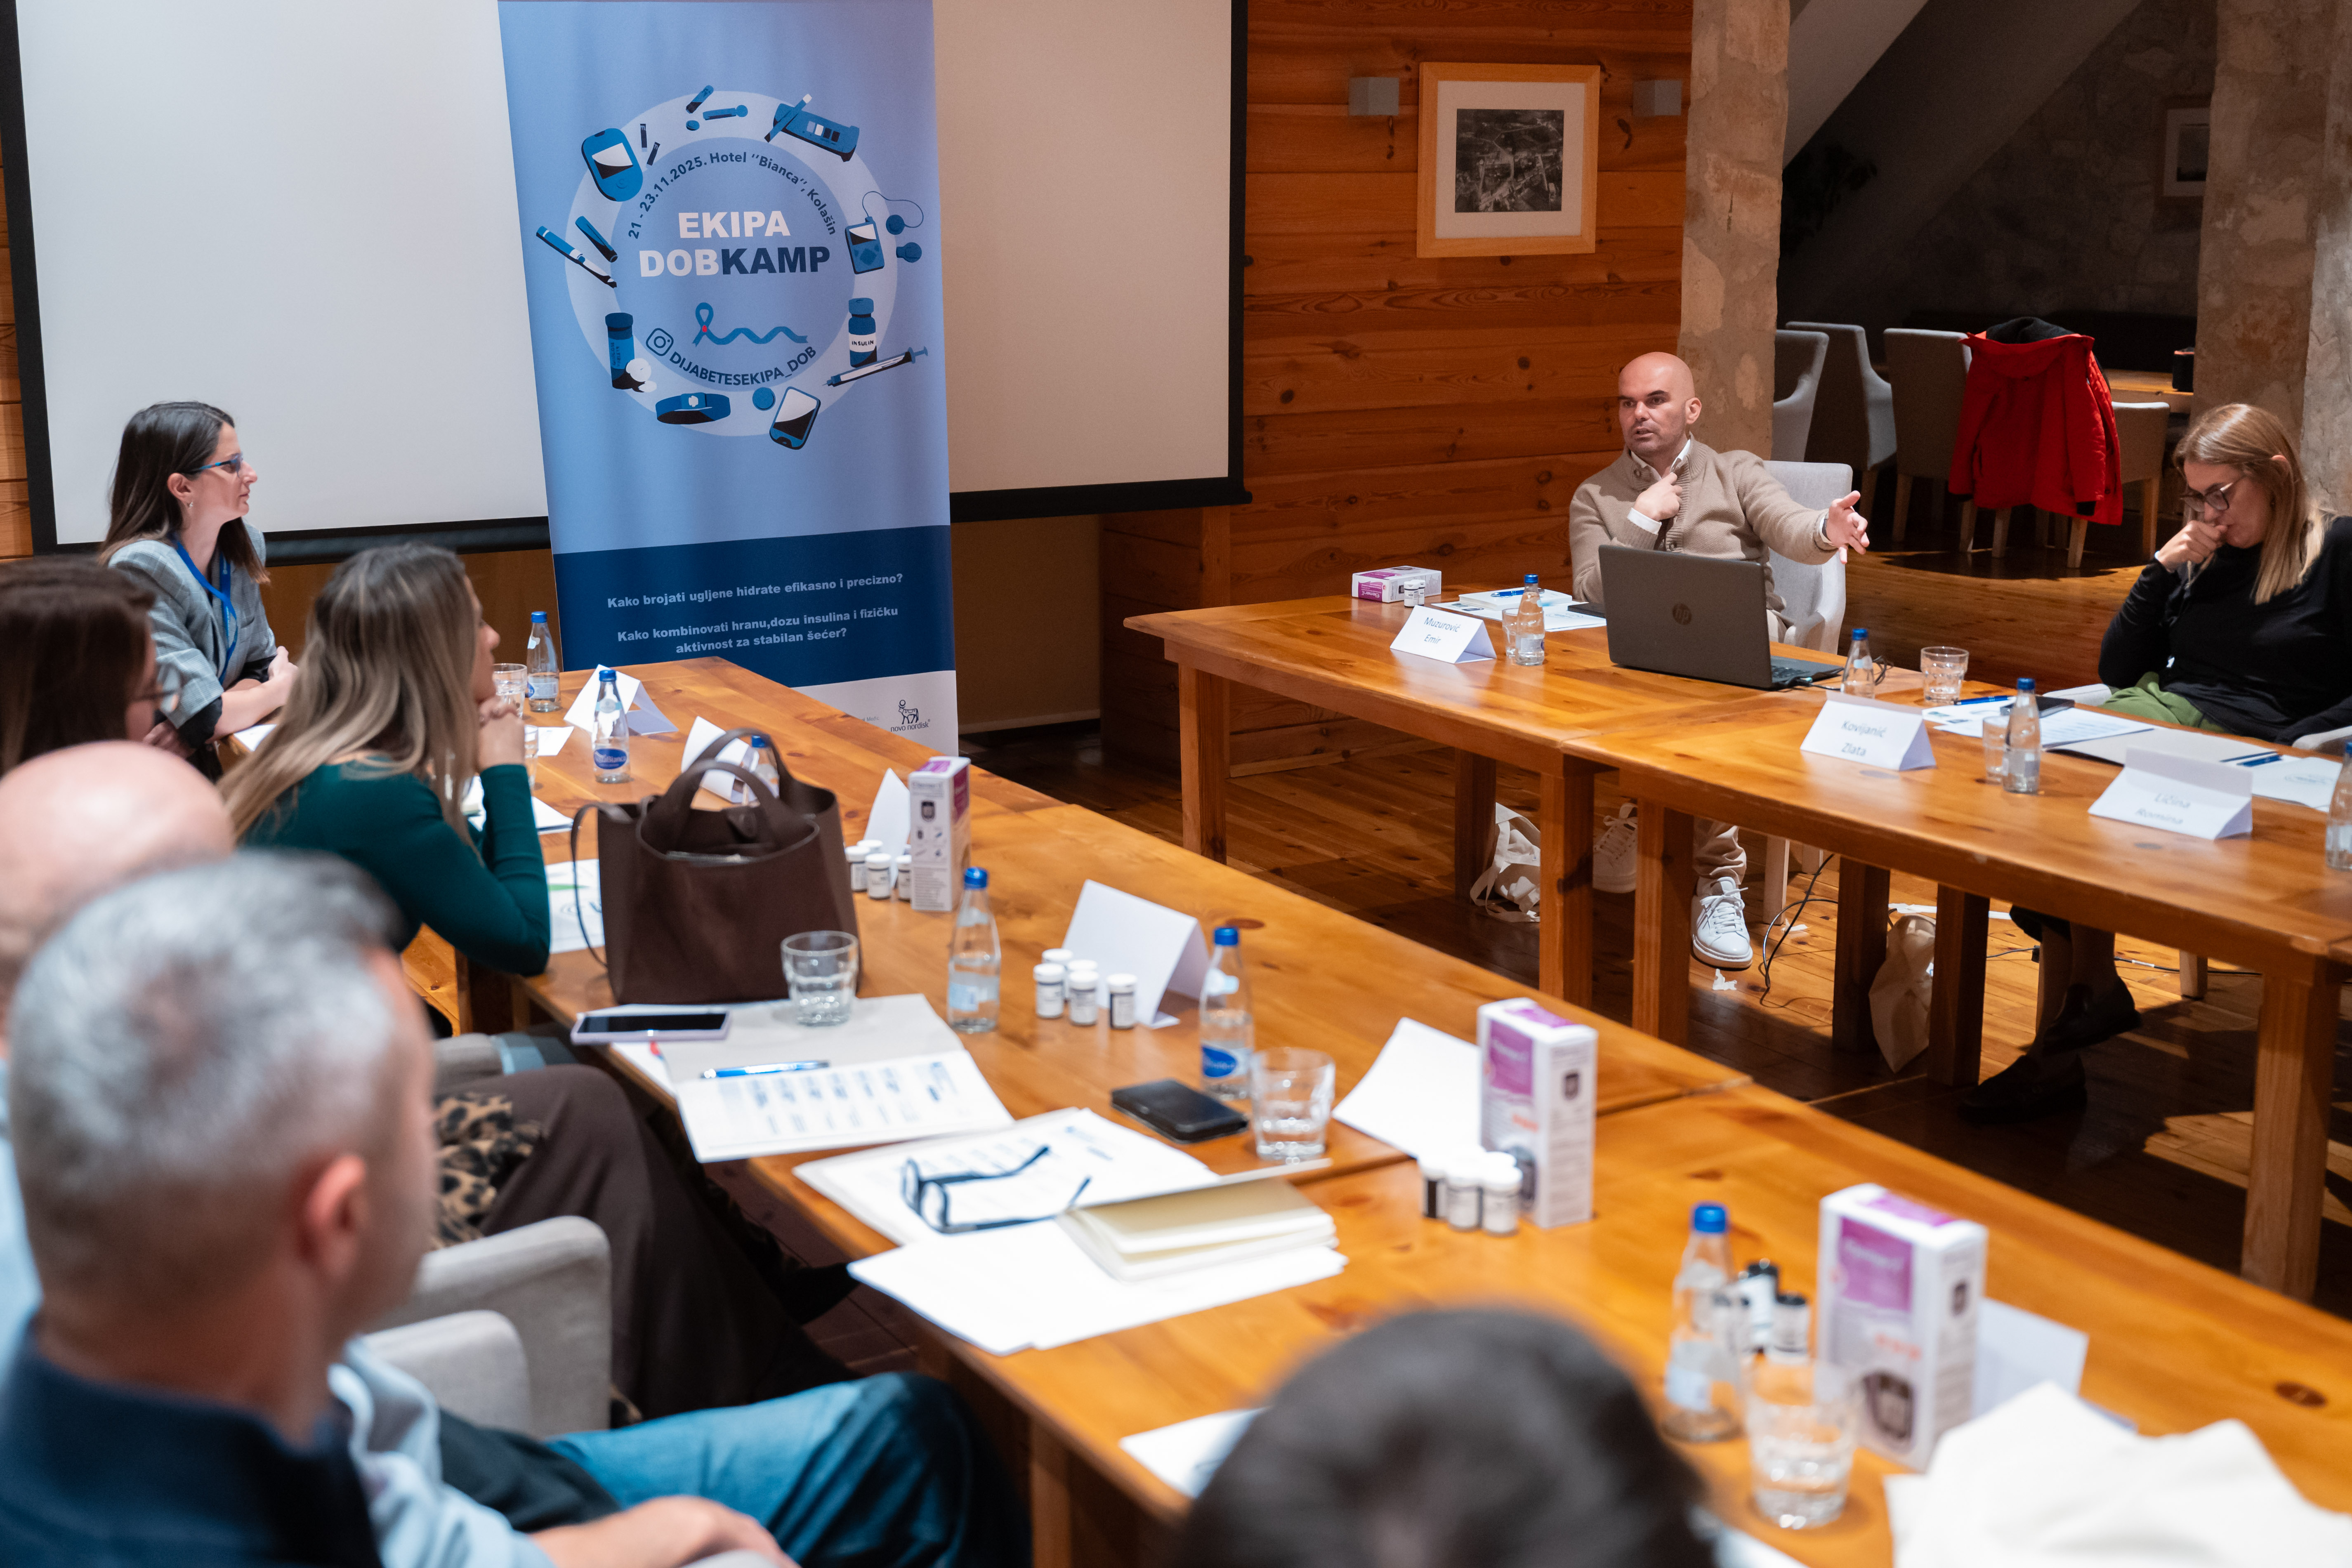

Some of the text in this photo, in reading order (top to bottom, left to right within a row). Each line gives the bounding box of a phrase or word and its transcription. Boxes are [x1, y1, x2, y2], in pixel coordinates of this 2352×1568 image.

[628, 222, 641, 239] 21
[640, 156, 707, 212] 23.11.2025.
[710, 152, 747, 163] Hotel
[807, 188, 836, 235] Kolašin
[679, 210, 791, 238] EKIPA
[639, 246, 830, 277] DOBKAMP
[669, 346, 817, 385] DIJABETESEKIPA_DOB
[607, 573, 903, 608] Kako brojati ugljene hidrate efikasno i precizno?
[618, 607, 898, 642] Kako kombinovati hranu,dozu insulina i fizičku
[1424, 617, 1461, 632] Muzurović
[1424, 634, 1441, 644] Emir
[676, 627, 847, 653] aktivnost za stabilan šećer?
[1841, 742, 1866, 757] Zlata
